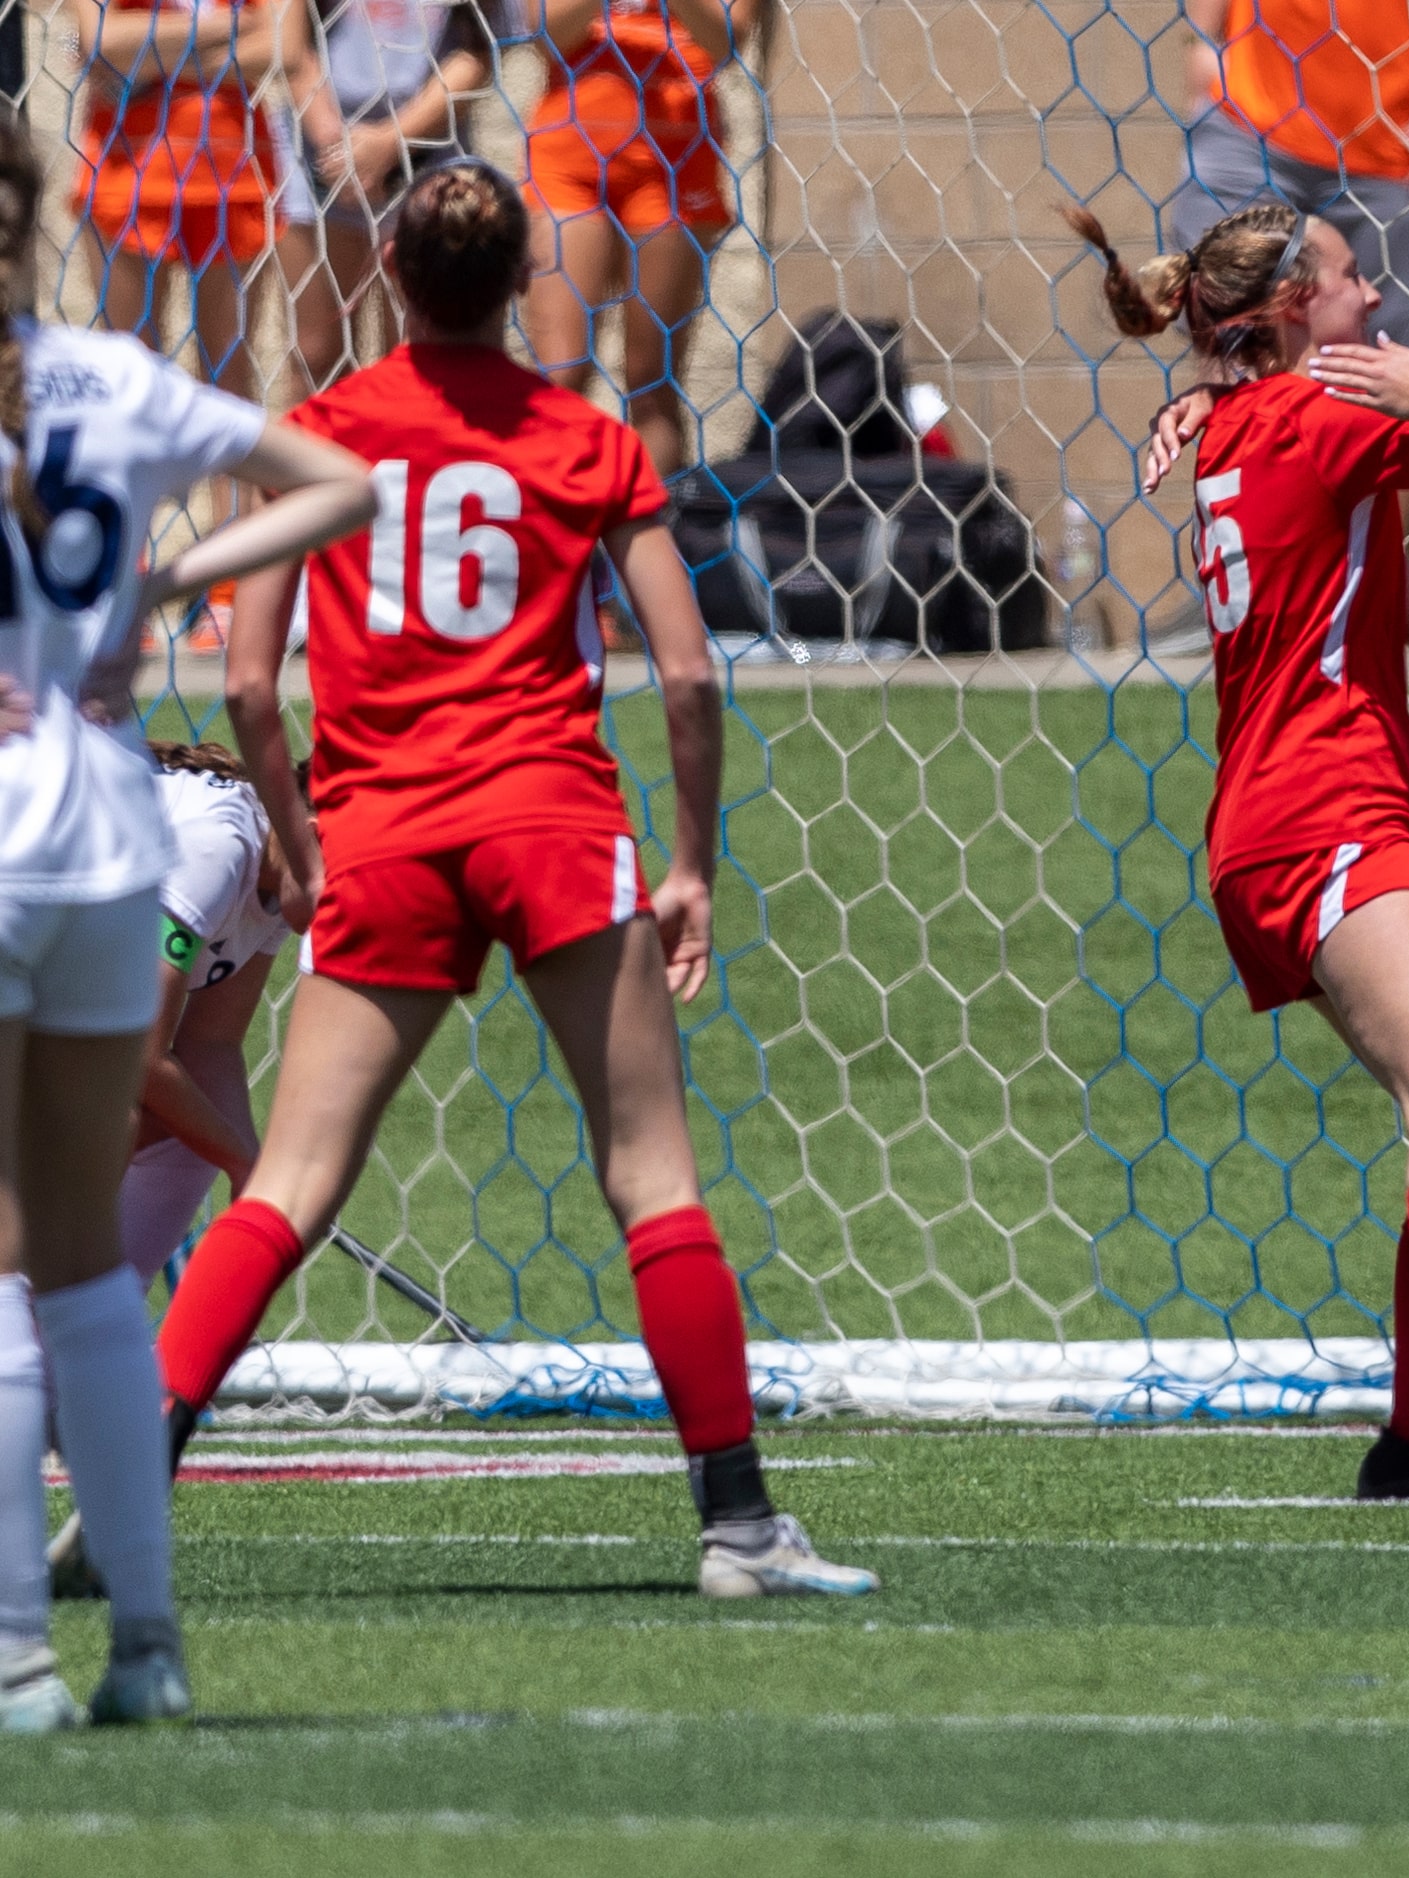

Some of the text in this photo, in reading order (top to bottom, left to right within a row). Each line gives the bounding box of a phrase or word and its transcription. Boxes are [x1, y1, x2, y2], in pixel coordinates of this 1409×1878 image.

[0, 424, 122, 618] 6
[367, 459, 522, 643] 16
[1192, 467, 1252, 634] 5
[165, 929, 193, 960] C
